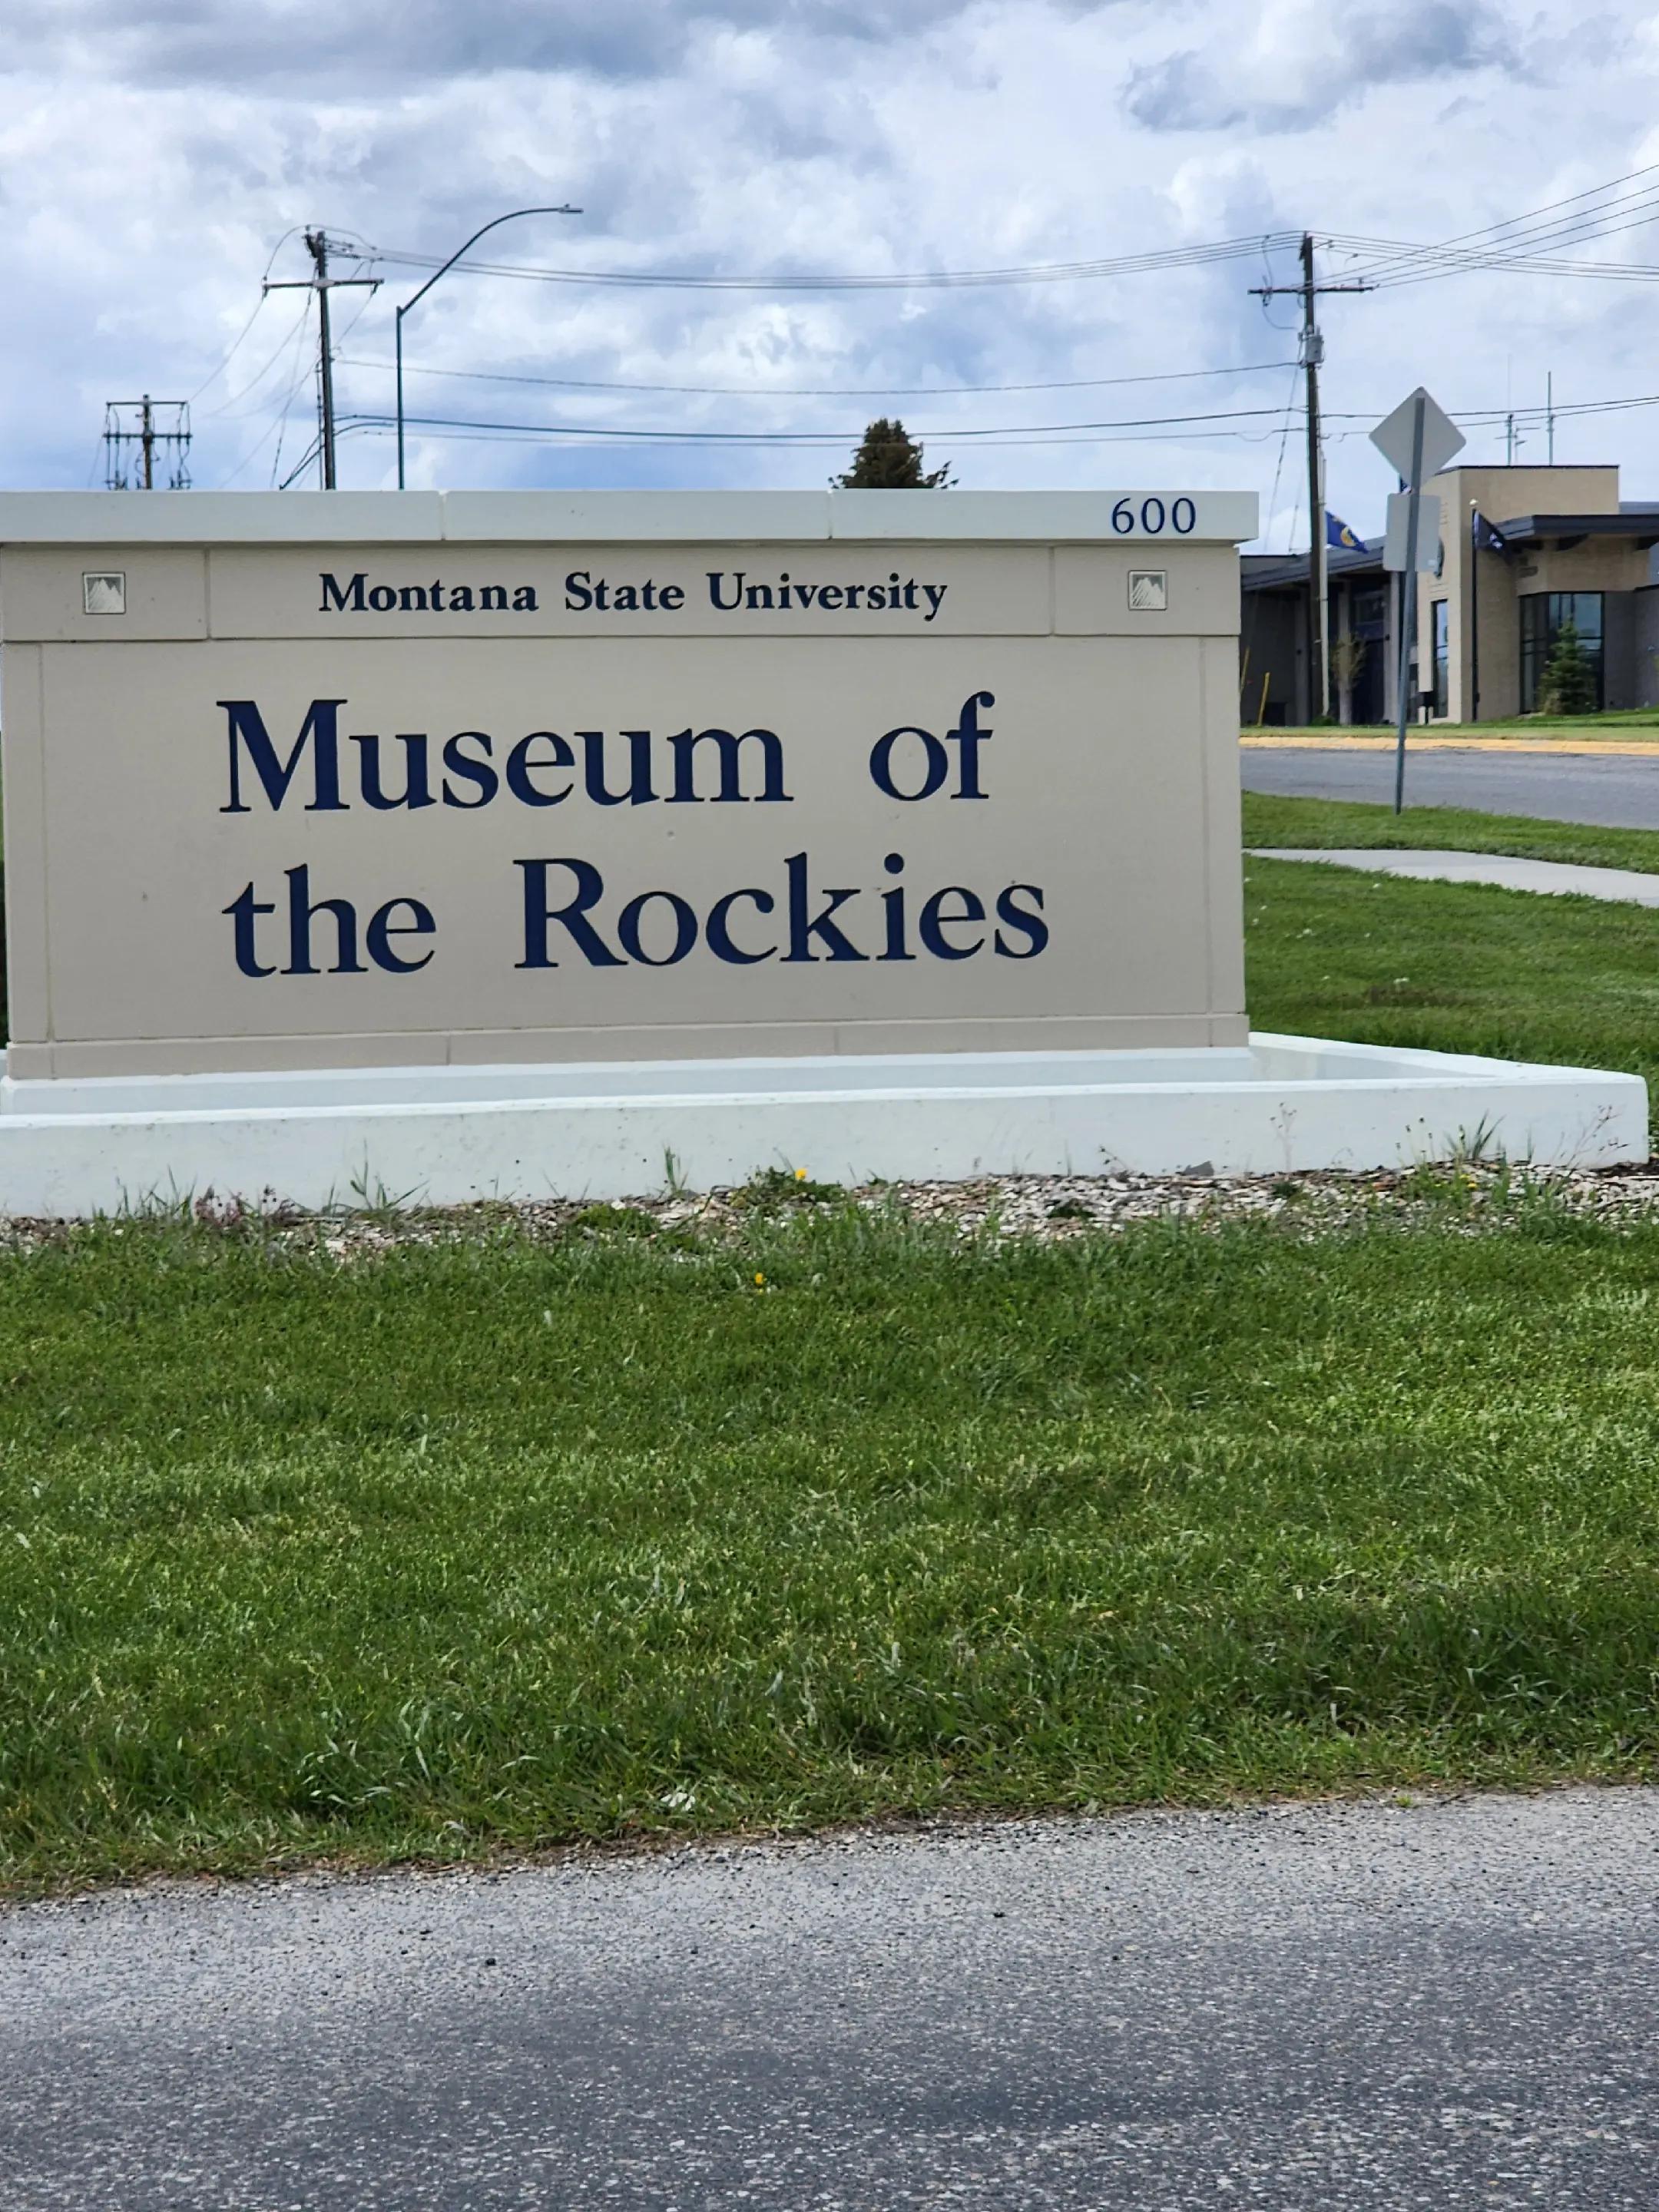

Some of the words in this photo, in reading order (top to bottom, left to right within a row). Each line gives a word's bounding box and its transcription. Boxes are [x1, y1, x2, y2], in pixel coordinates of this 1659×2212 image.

[1111, 498, 1196, 535] 600
[319, 573, 539, 612] Montana
[565, 571, 684, 611] State
[706, 572, 948, 621] University
[216, 699, 794, 813] Museum
[869, 691, 995, 801] of
[222, 863, 436, 977] the
[512, 852, 1048, 969] Rockies
